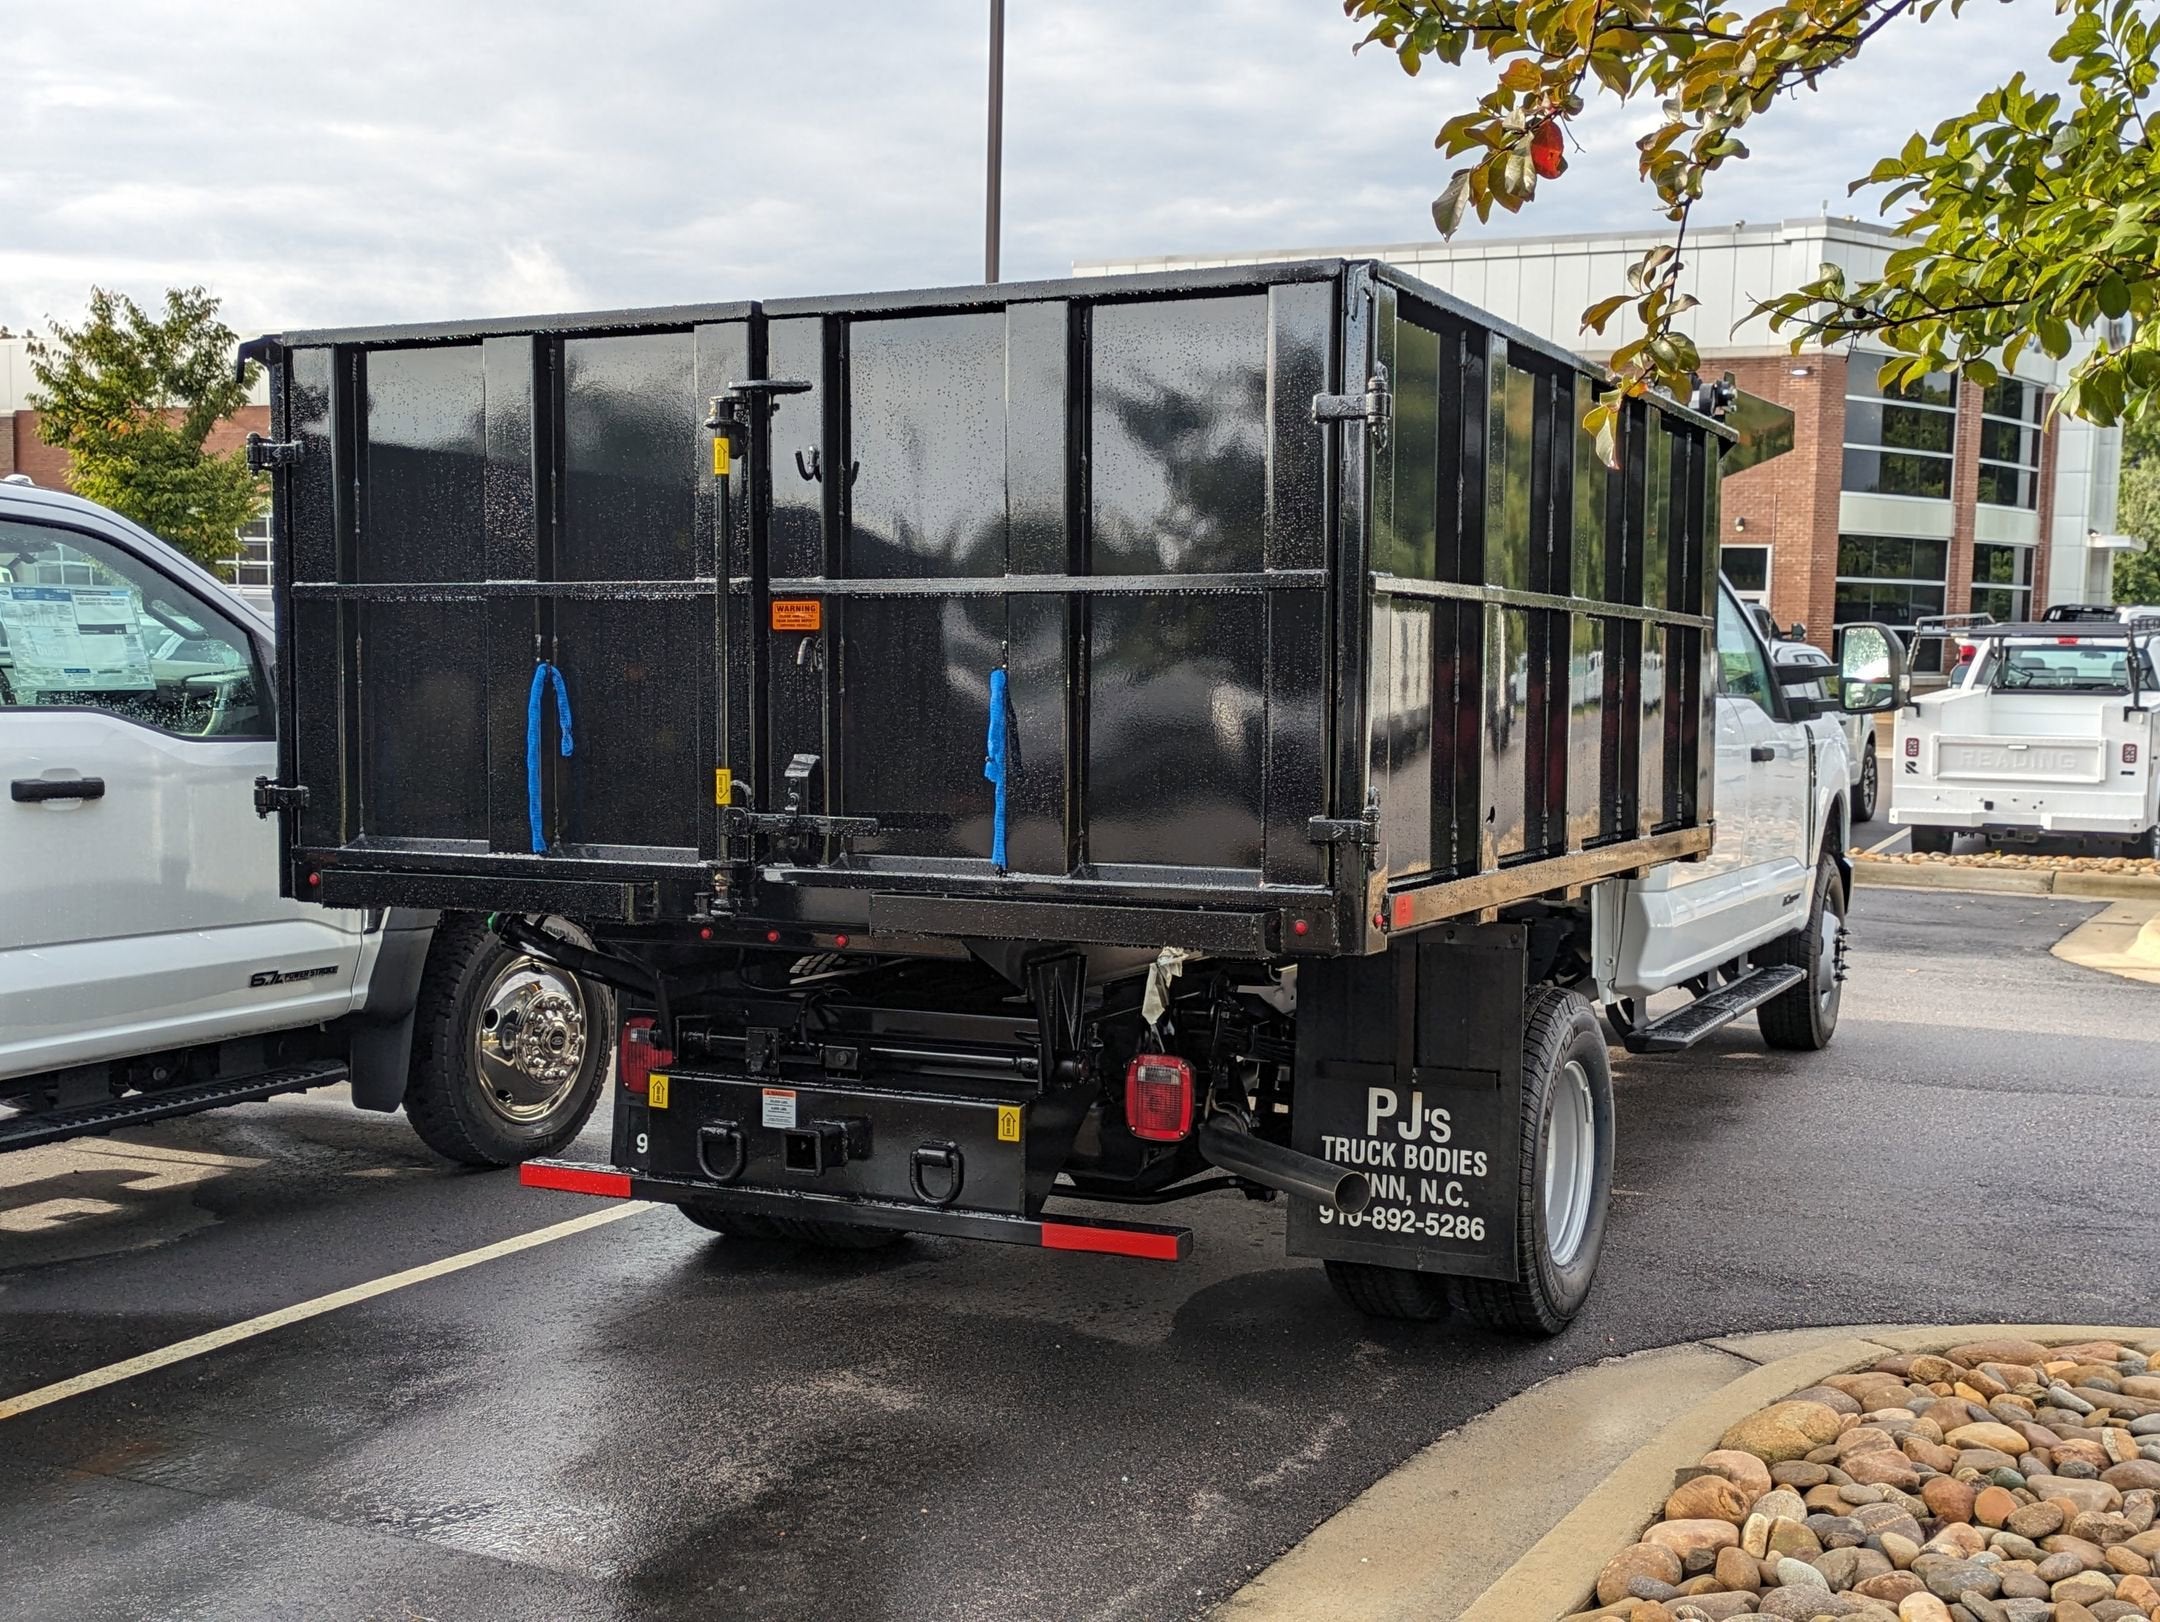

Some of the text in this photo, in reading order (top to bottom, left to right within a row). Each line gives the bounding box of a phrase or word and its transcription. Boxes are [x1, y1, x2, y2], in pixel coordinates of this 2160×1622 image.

[1962, 749, 2077, 770] READING
[636, 1132, 648, 1154] 9
[1321, 1135, 1487, 1177] TRUCK BODIES
[1420, 1178, 1469, 1208] N.C.
